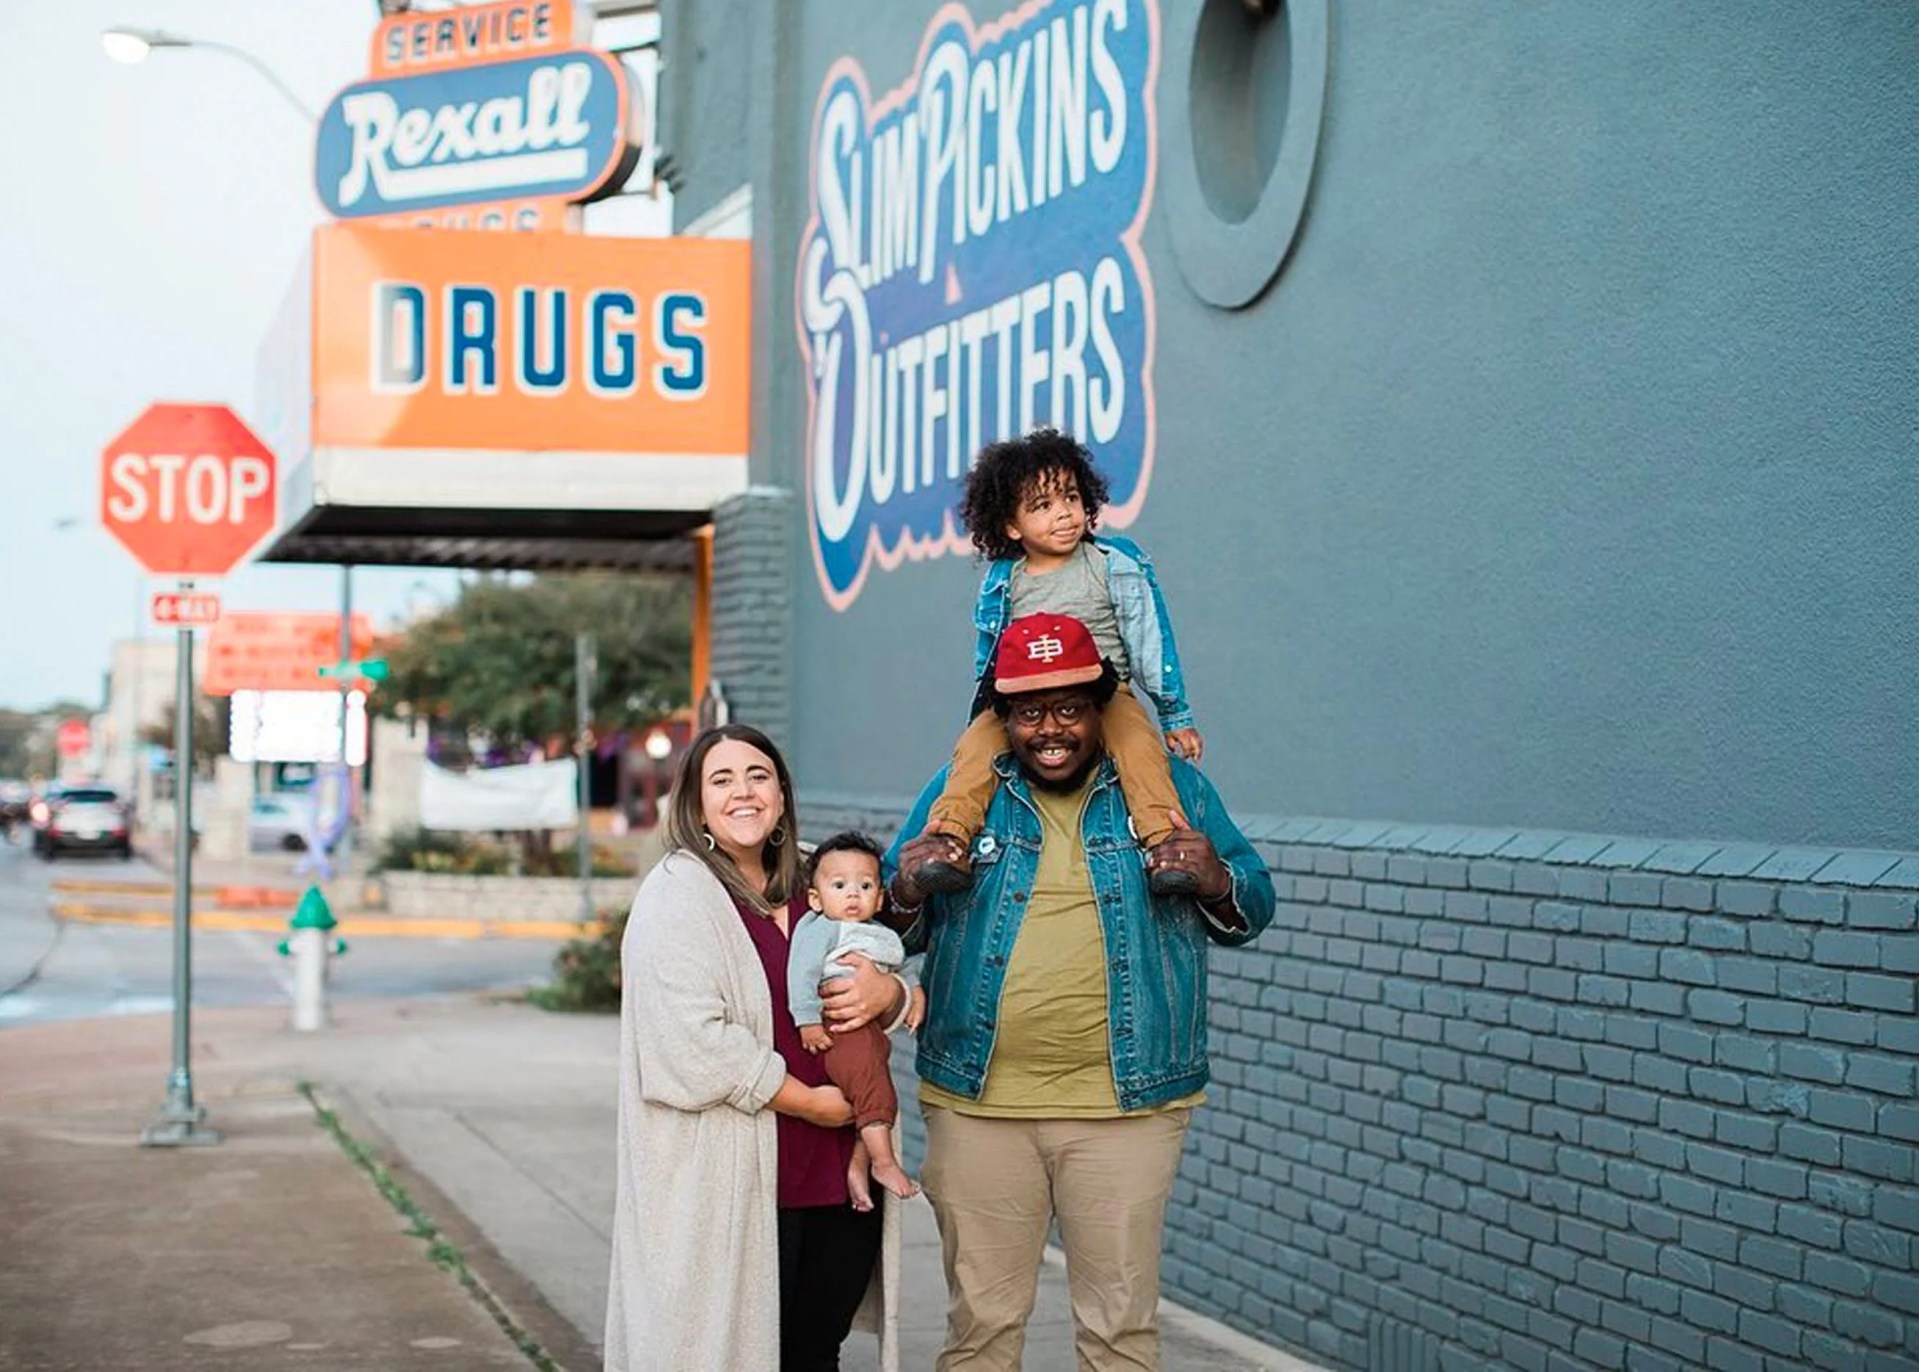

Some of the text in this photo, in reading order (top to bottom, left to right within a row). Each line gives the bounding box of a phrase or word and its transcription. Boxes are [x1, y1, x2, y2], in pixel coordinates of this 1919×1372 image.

[384, 1, 555, 68] SERVICE
[338, 63, 591, 208] Rexall
[371, 279, 709, 400] DRUGS
[814, 257, 1125, 542] OUTFITTERS
[108, 453, 270, 525] STOP
